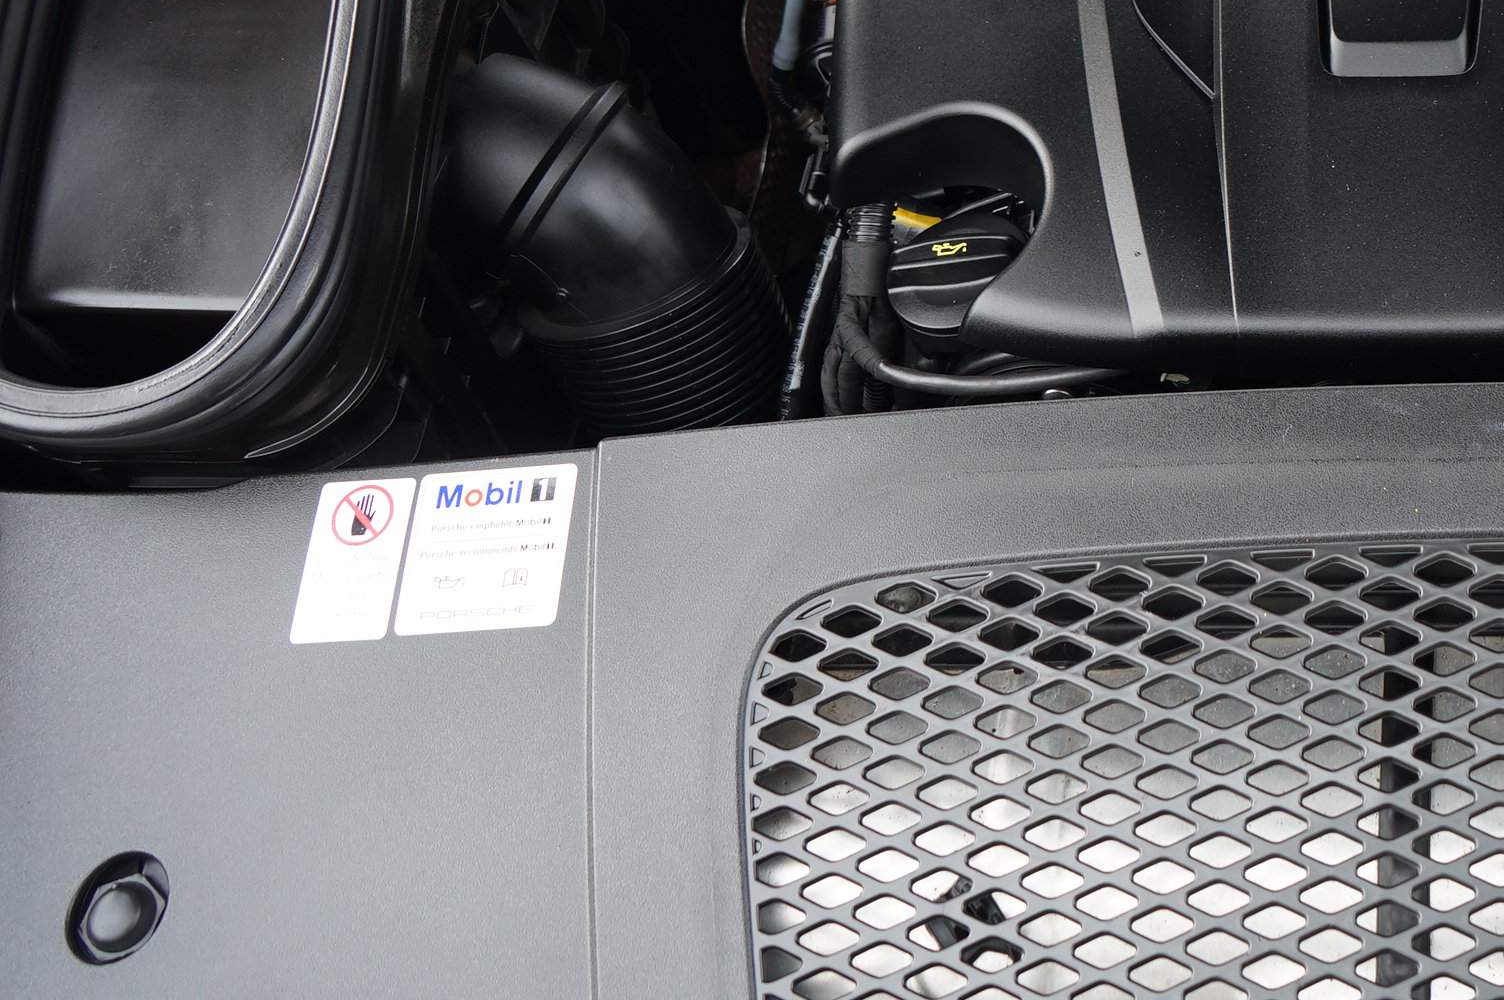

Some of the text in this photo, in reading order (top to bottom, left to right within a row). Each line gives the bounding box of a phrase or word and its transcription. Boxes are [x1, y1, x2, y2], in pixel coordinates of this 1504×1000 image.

[435, 480, 523, 509] Mobil
[431, 522, 468, 534] Porsche
[515, 517, 543, 527] Mobil
[420, 549, 457, 560] Porsche
[459, 545, 518, 556] recommends
[519, 543, 546, 553] Mobil
[419, 604, 536, 621] PORSCHE
